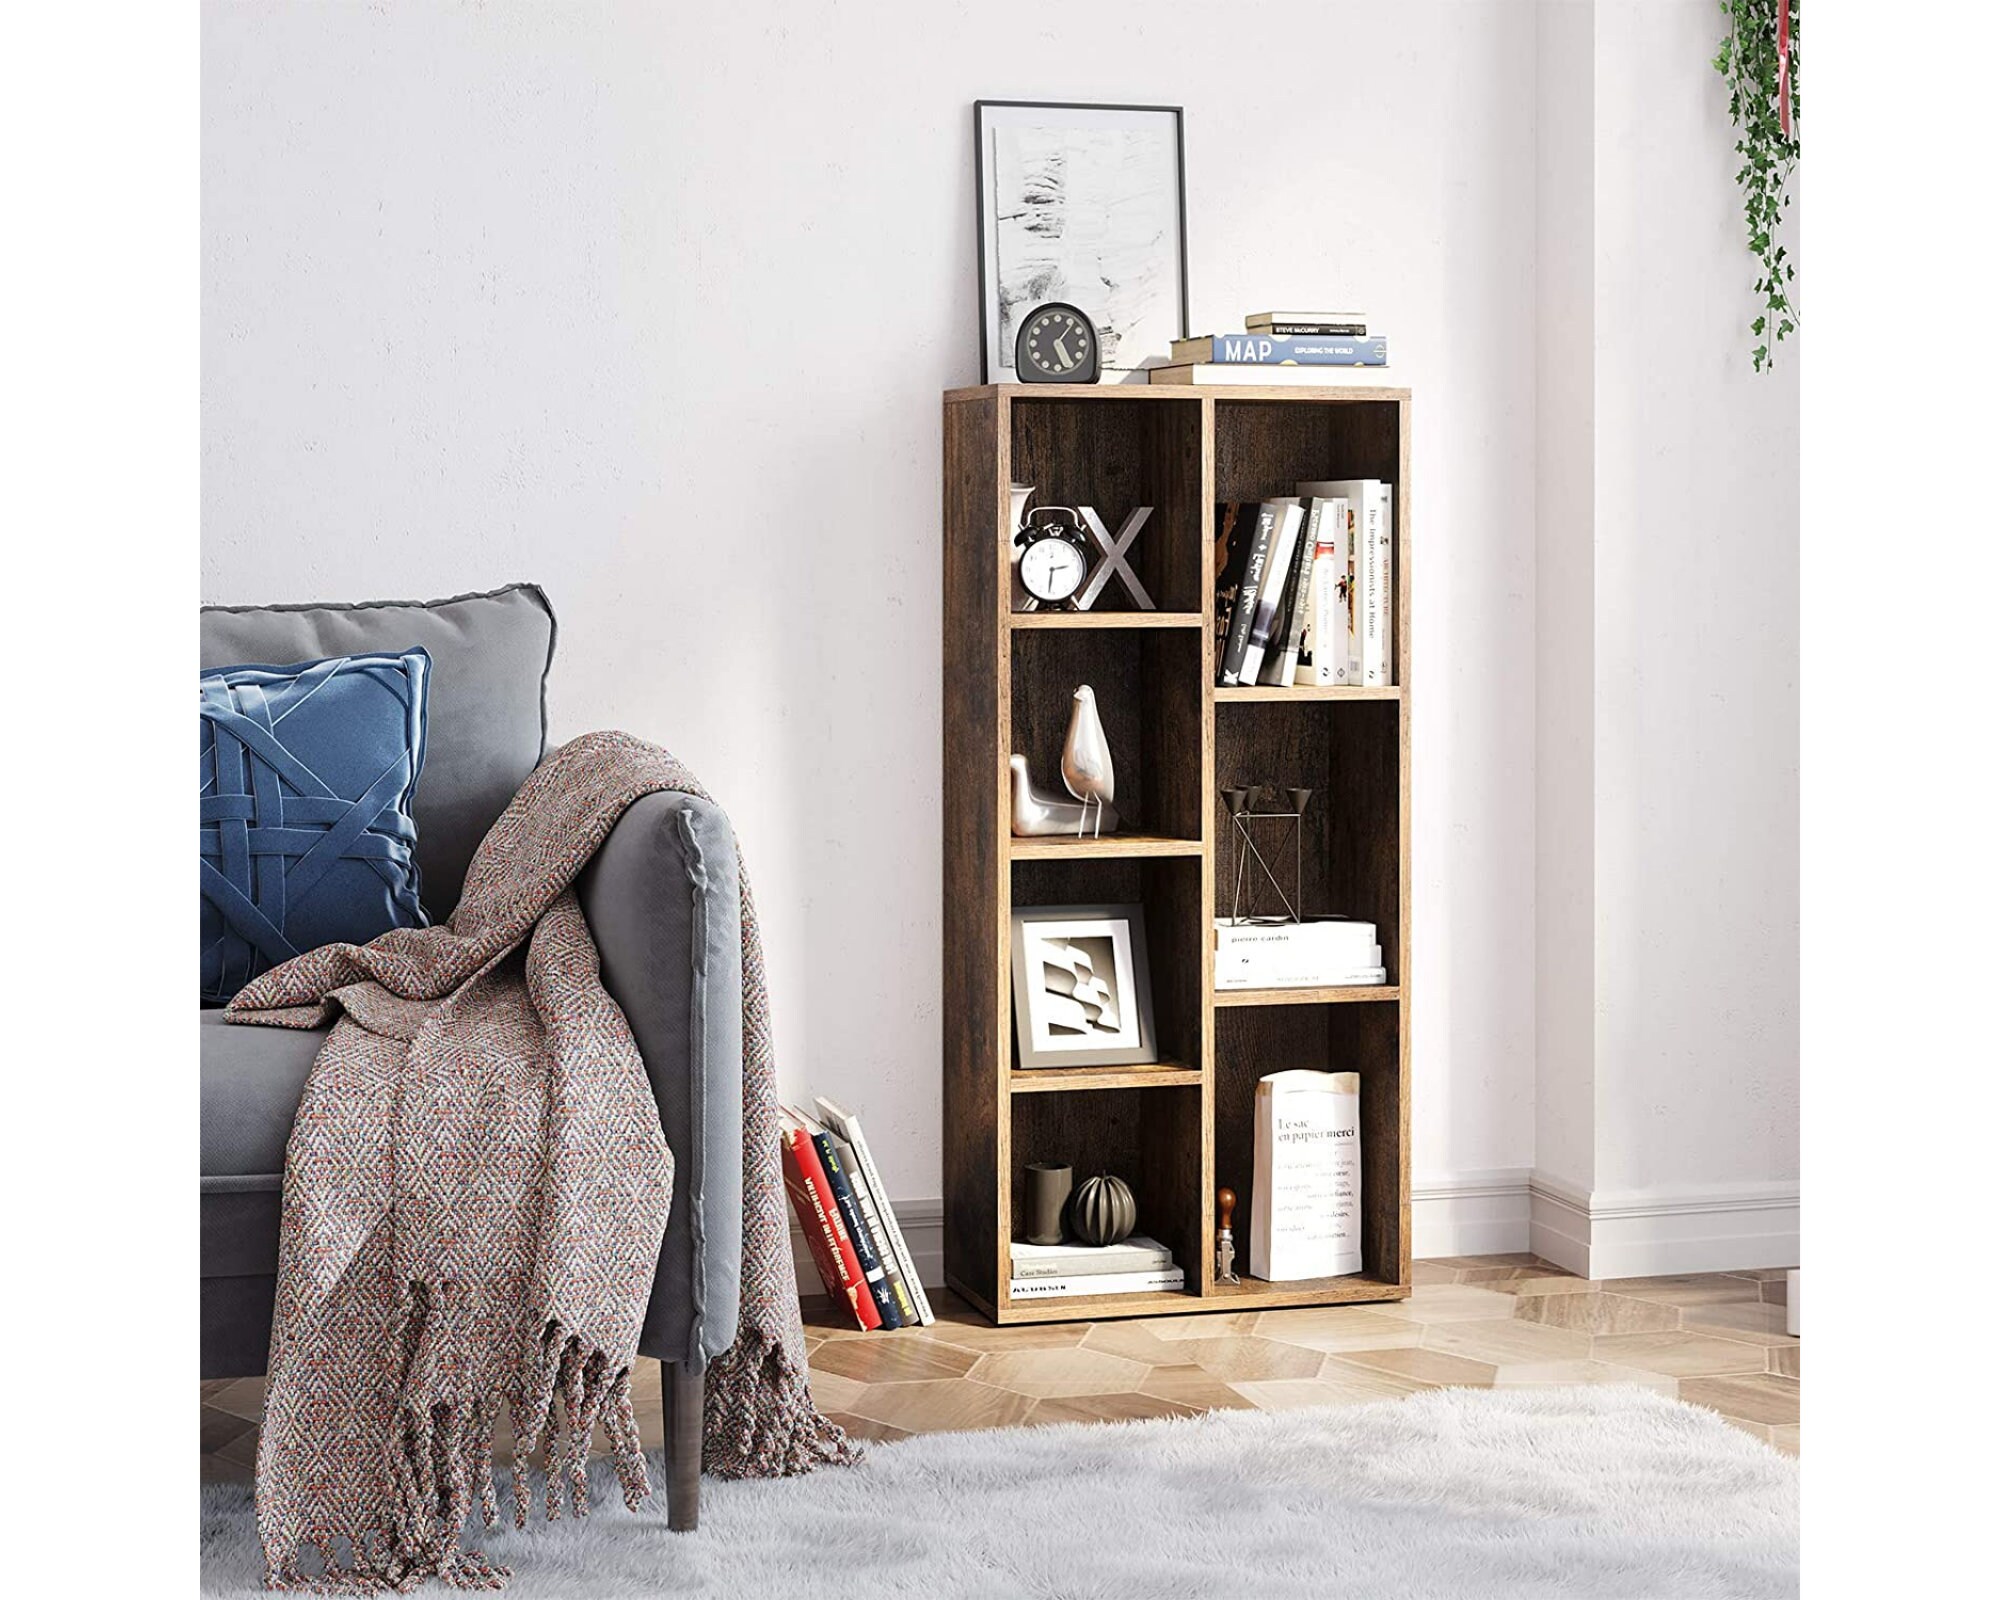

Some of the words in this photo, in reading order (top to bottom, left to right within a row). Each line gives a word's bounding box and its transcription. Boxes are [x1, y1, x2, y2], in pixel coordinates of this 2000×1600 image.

[1225, 340, 1272, 362] MAP
[1334, 347, 1354, 355] WORLD
[1368, 508, 1377, 525] The
[1367, 527, 1377, 597] Impressionists
[1368, 610, 1377, 639] Home
[1260, 934, 1290, 942] cardin
[1278, 1132, 1290, 1142] en
[1292, 1131, 1323, 1144] papier
[1326, 1126, 1355, 1138] merci
